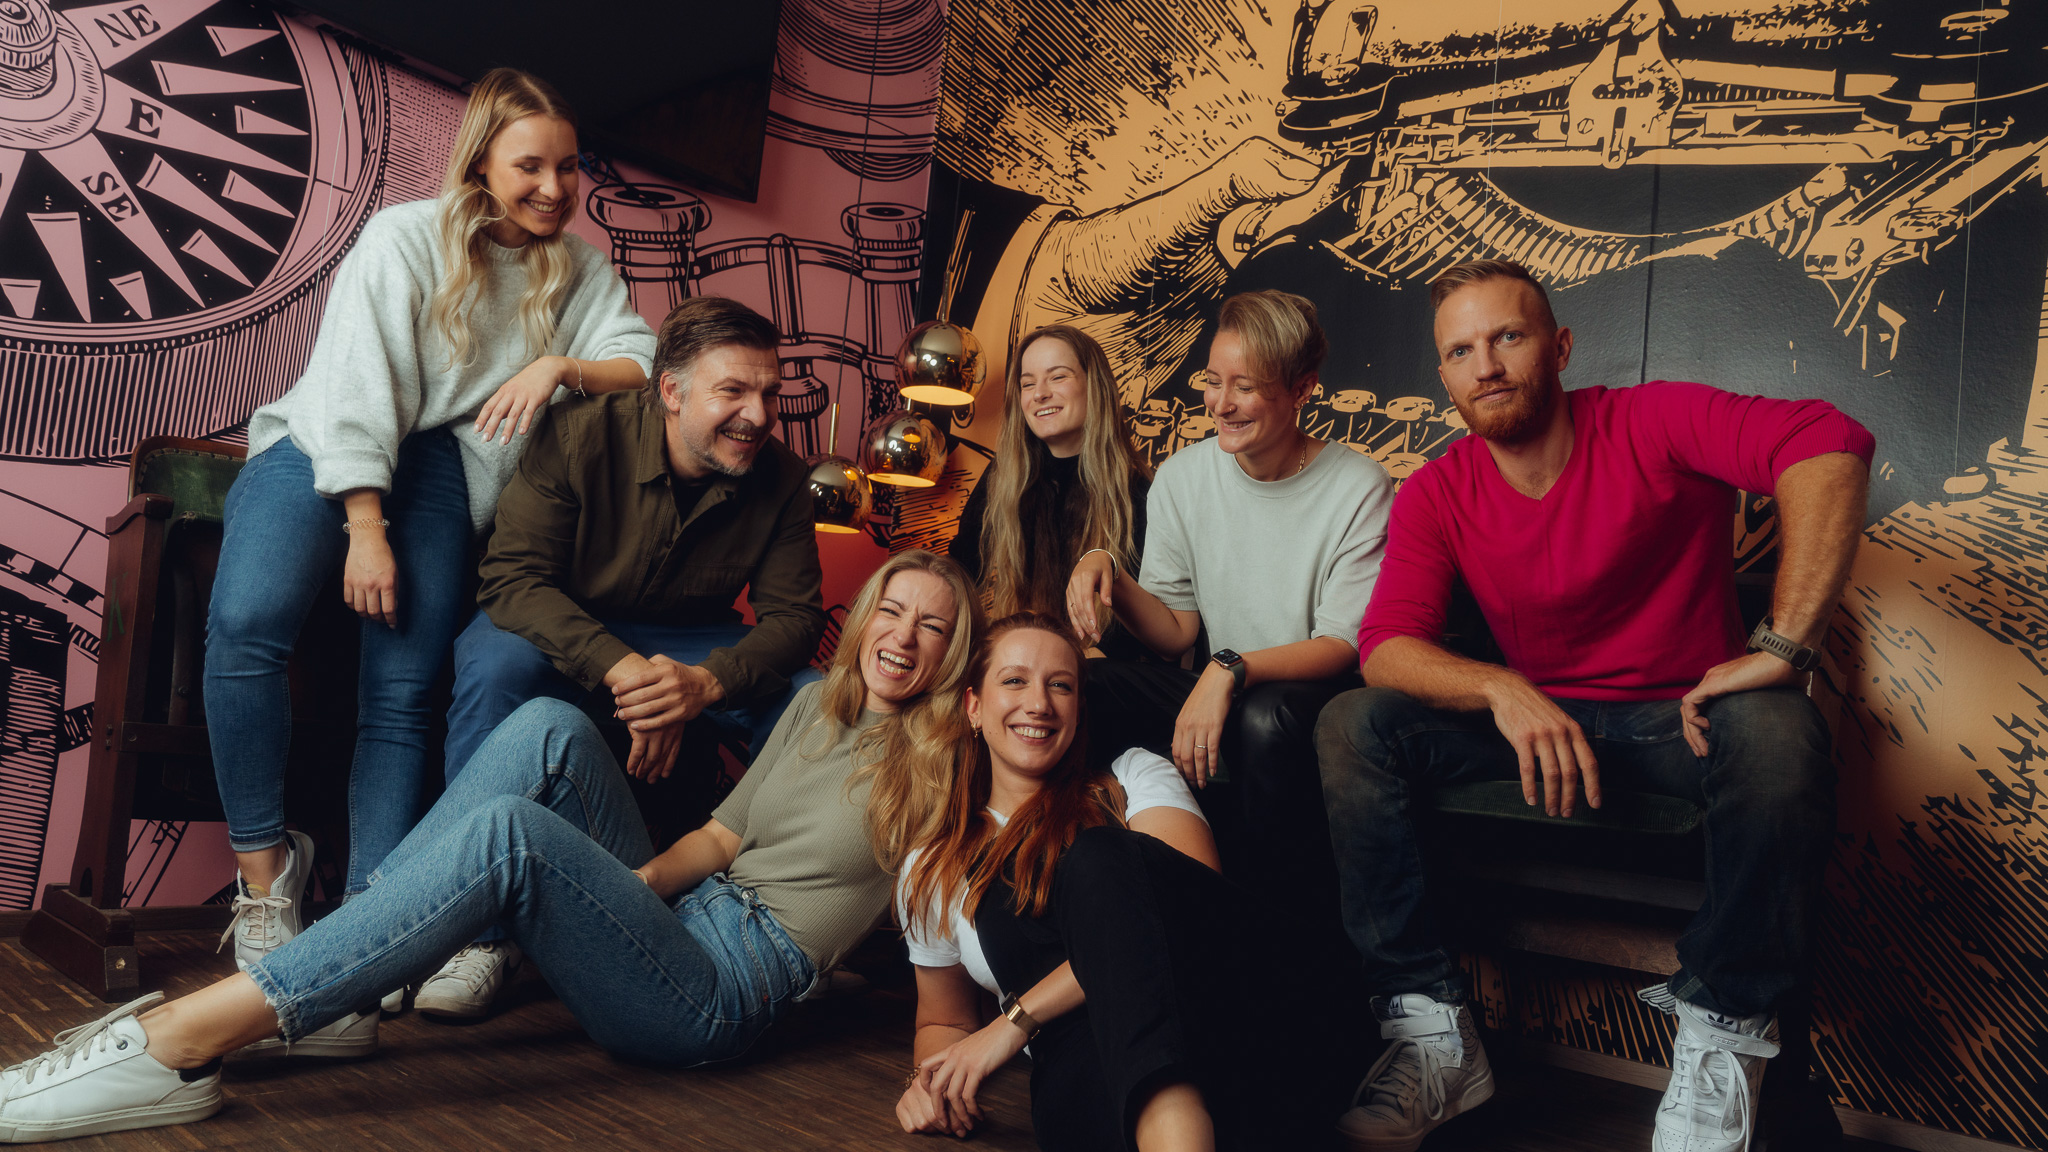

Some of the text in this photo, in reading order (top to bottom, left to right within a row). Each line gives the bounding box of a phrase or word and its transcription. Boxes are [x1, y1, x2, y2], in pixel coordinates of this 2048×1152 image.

[94, 4, 161, 47] NE
[125, 98, 163, 139] E
[80, 171, 140, 222] SE
